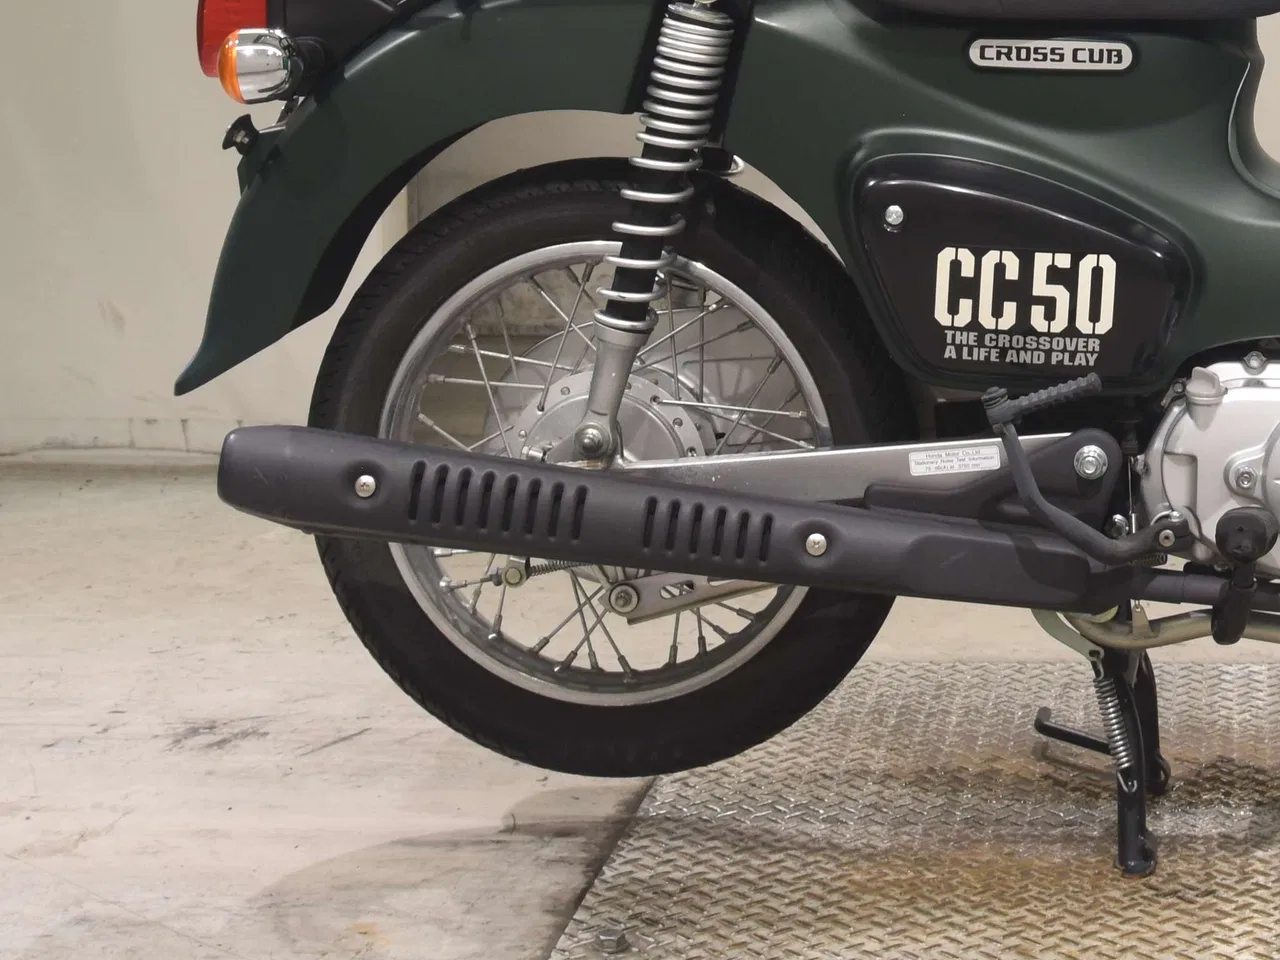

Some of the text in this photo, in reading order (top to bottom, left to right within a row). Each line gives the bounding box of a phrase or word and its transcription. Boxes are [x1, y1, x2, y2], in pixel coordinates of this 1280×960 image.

[979, 45, 1123, 64] CROSS CUB
[944, 330, 1100, 352] THE CROSSOVER
[943, 345, 1099, 366] A LIFE AND PLAY
